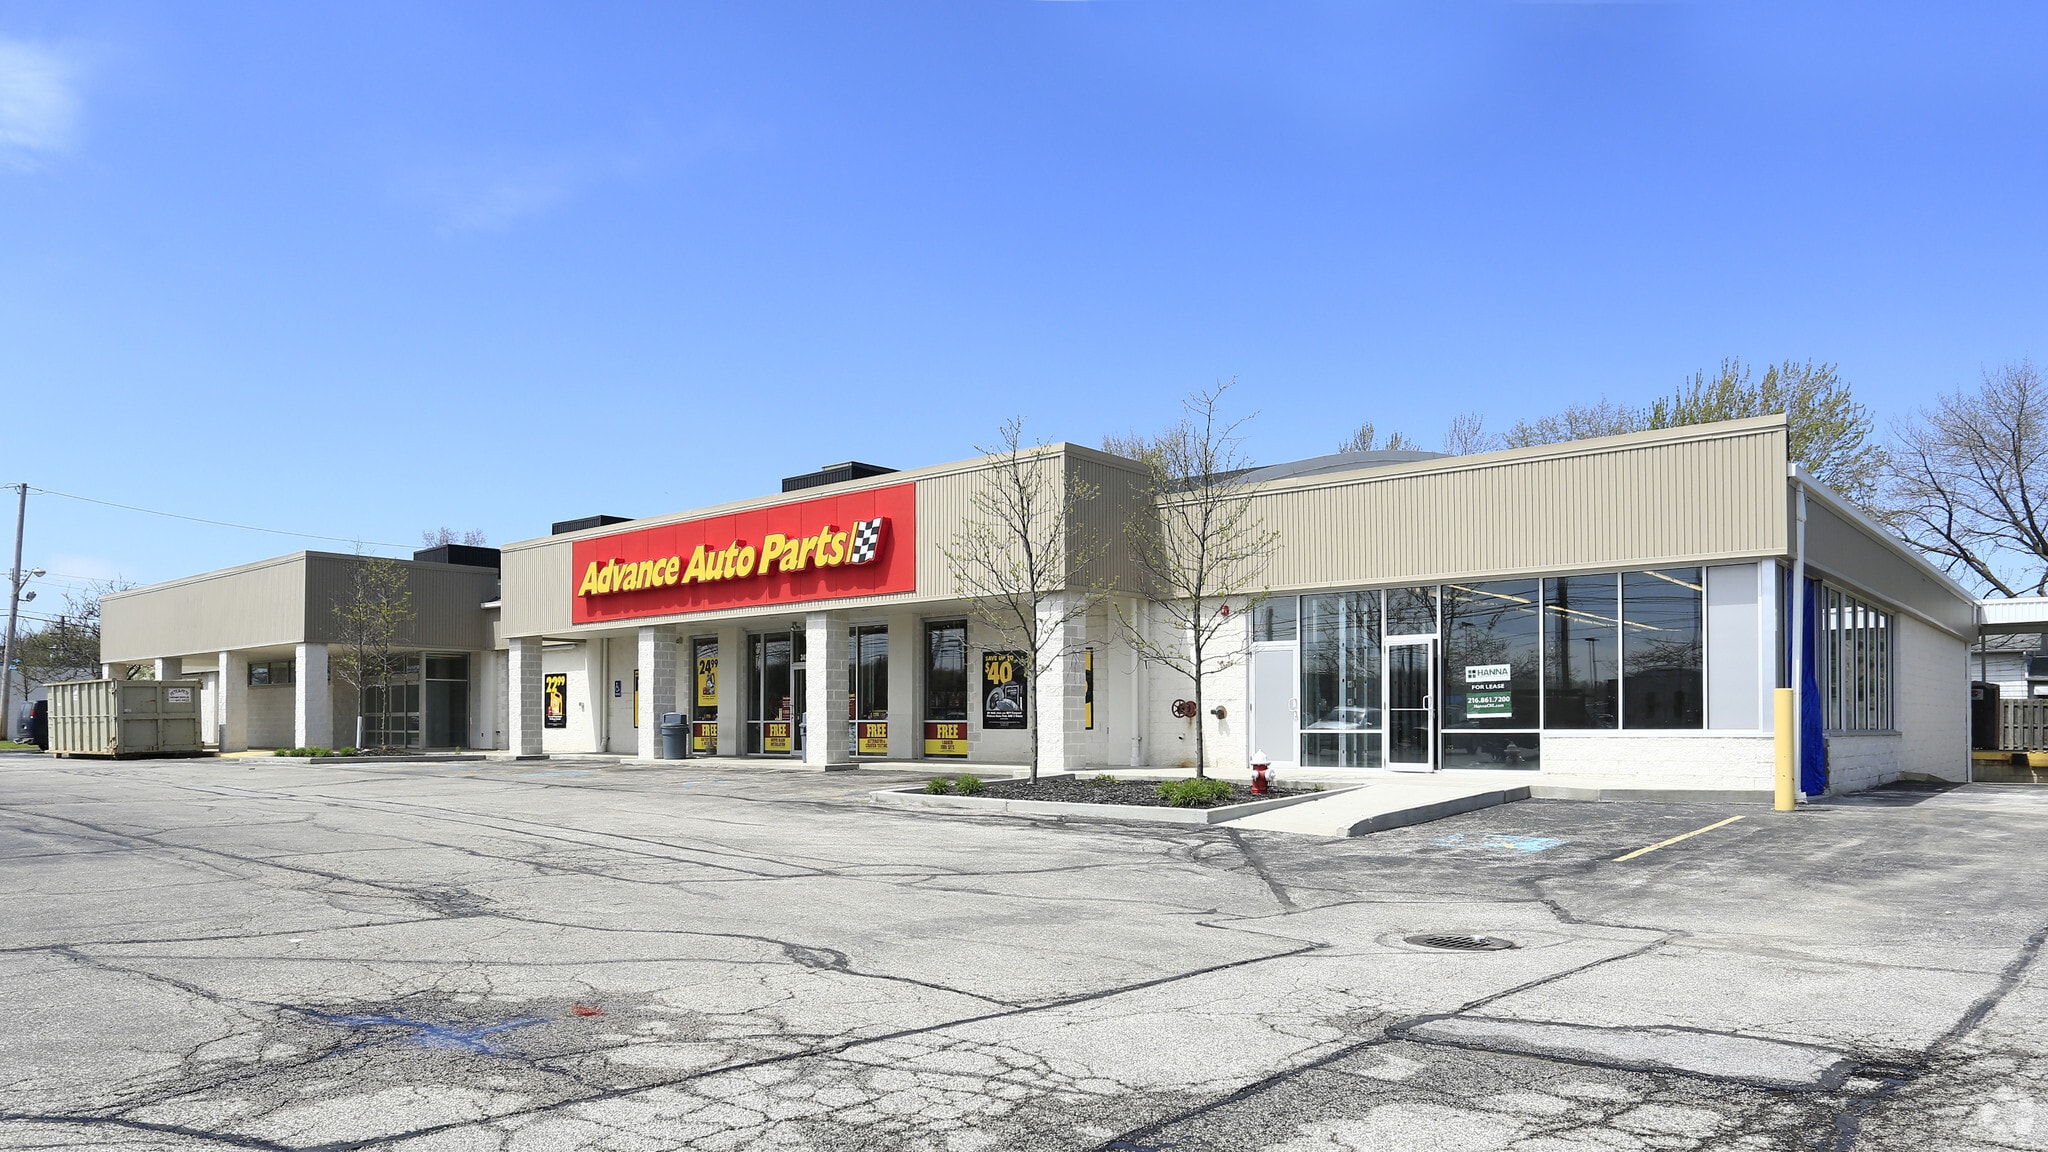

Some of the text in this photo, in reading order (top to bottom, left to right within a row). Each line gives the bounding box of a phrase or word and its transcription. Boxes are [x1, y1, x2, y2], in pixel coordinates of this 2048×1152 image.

[578, 525, 849, 597] Advance Auto Parts
[985, 661, 1012, 684] $40
[1477, 668, 1508, 676] HANNA
[701, 724, 717, 736] FREE
[769, 724, 786, 736] FREE
[866, 723, 886, 737] FREE
[936, 724, 958, 738] FREE
